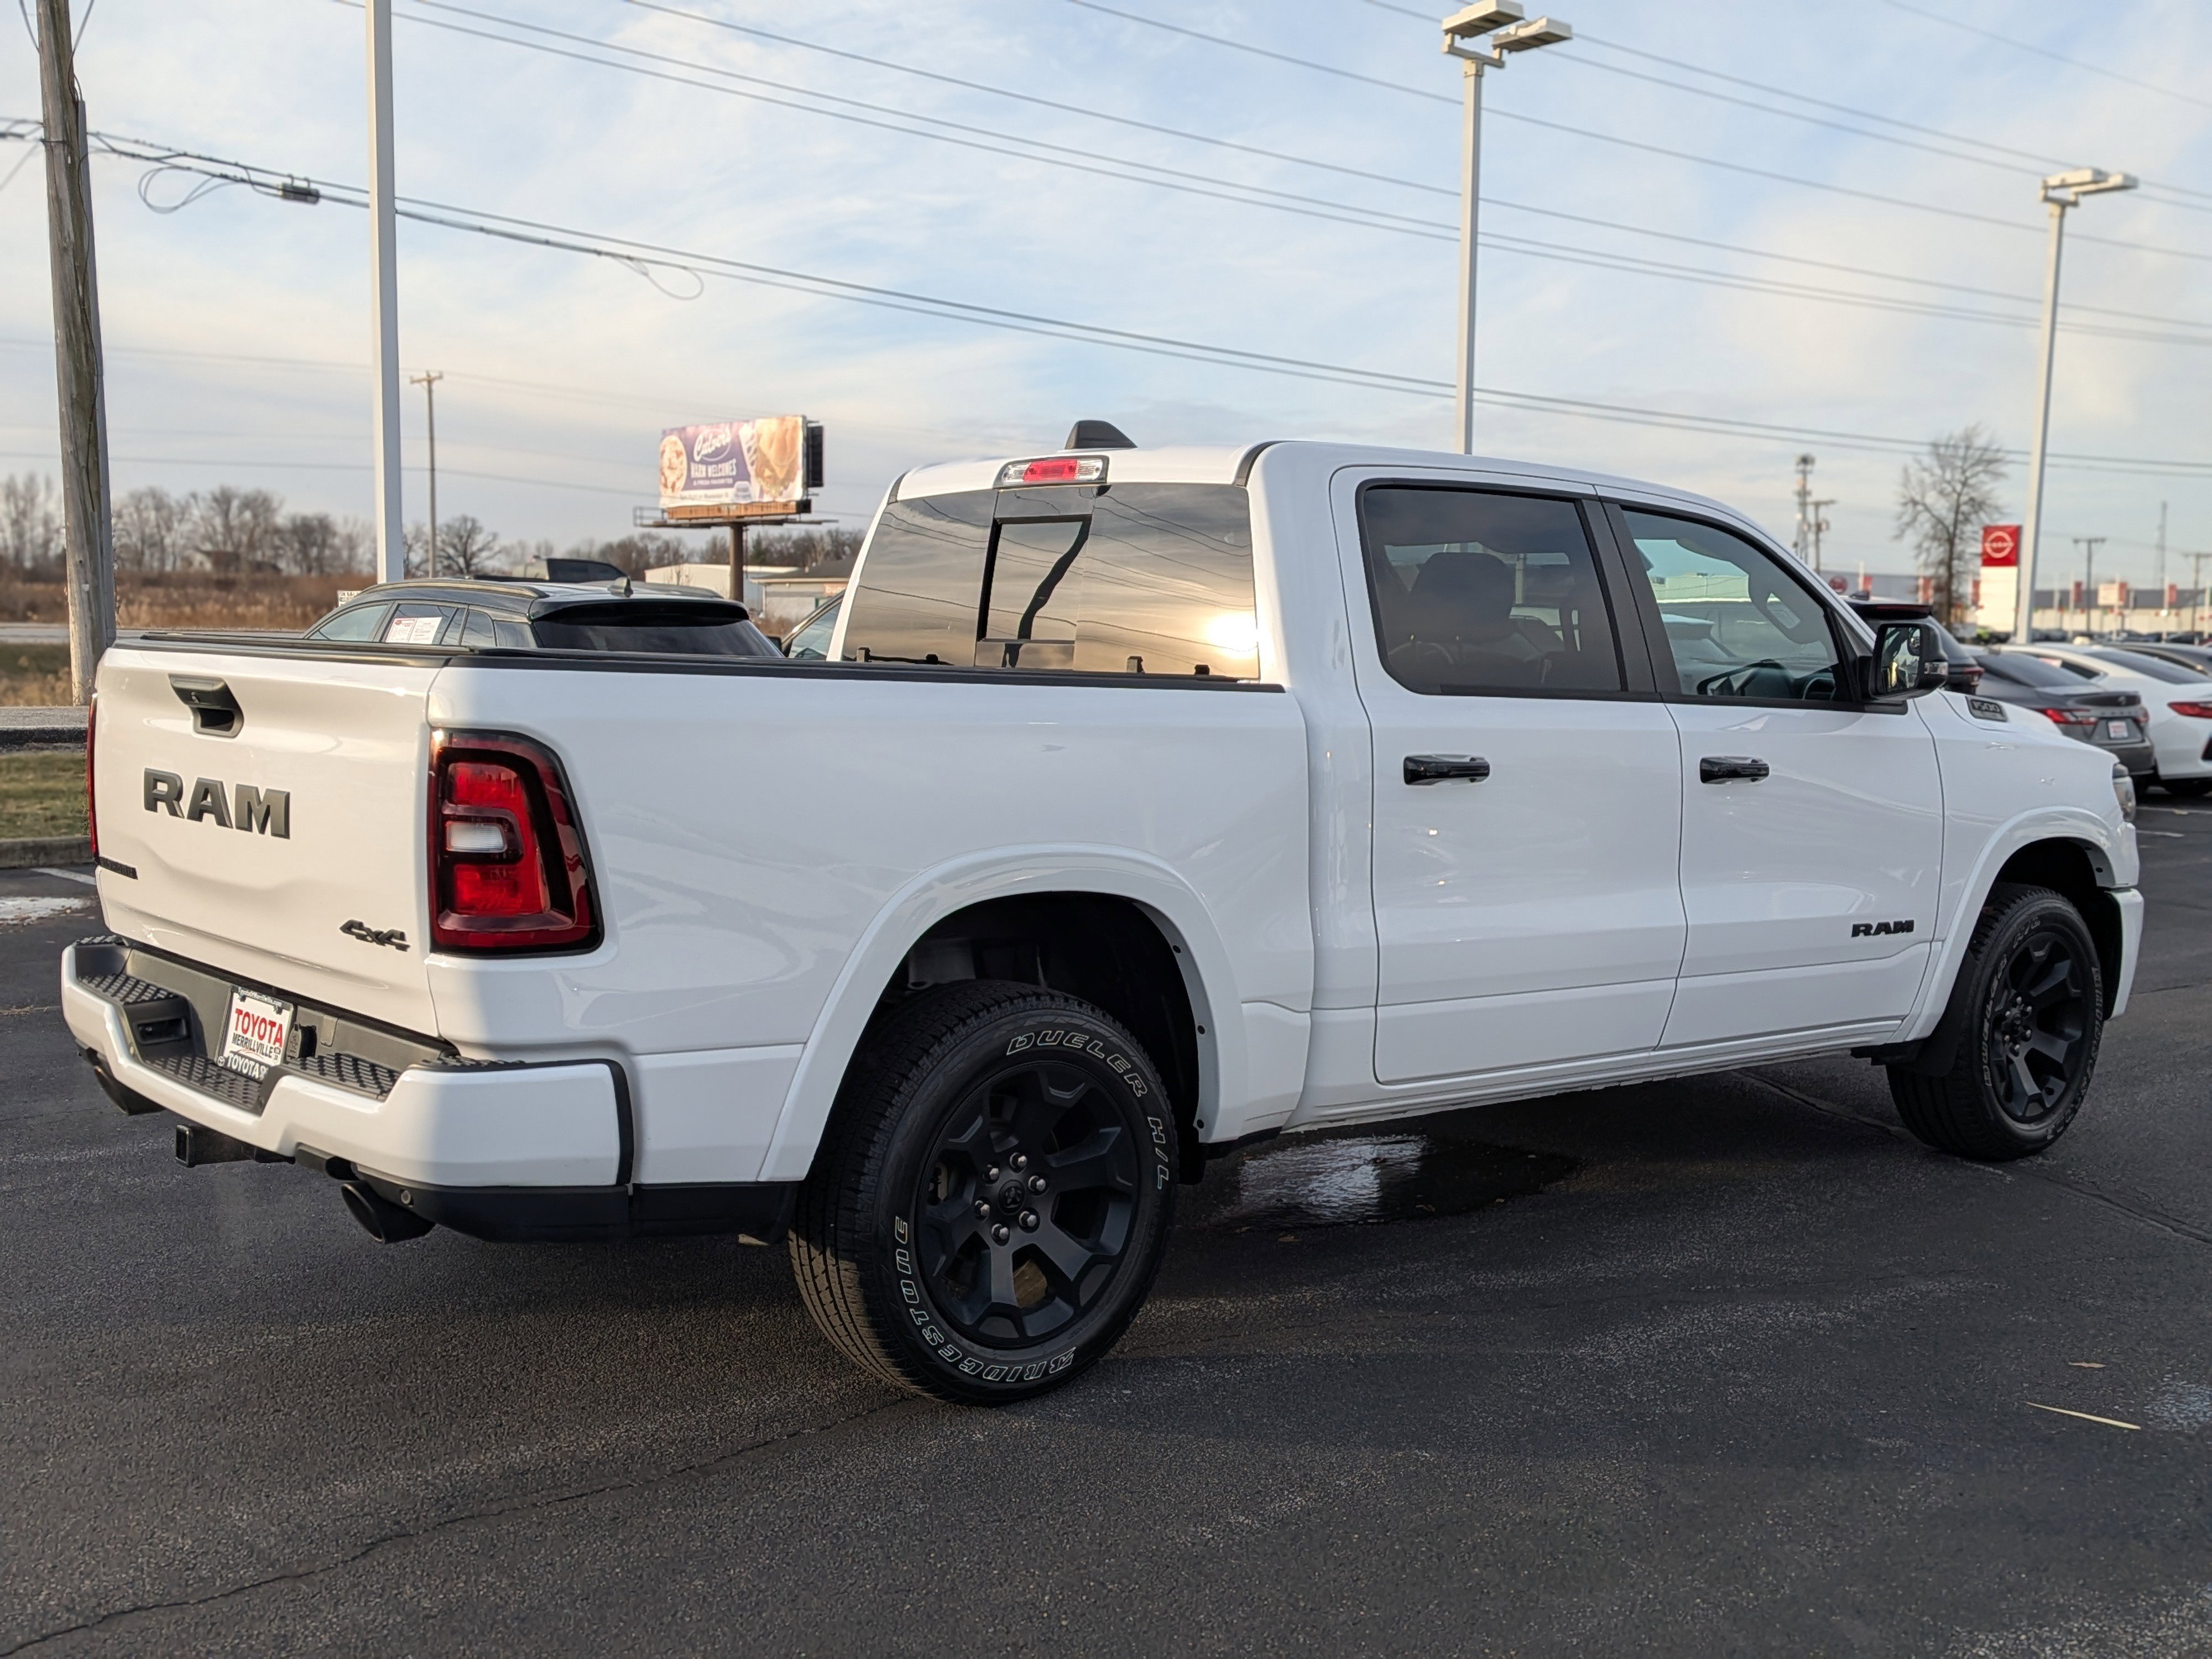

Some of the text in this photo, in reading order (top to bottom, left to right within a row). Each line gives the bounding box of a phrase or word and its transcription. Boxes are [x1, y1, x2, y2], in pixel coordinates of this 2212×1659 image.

[144, 767, 290, 839] RAM
[1851, 920, 1914, 938] RAM
[232, 1032, 274, 1058] MERRILLVILLE
[235, 1008, 283, 1048] TOYOTA
[227, 1052, 259, 1079] TOYOTA
[1006, 1030, 1170, 1190] DUELER H/L
[894, 1215, 1077, 1382] BRIDGESTONE
